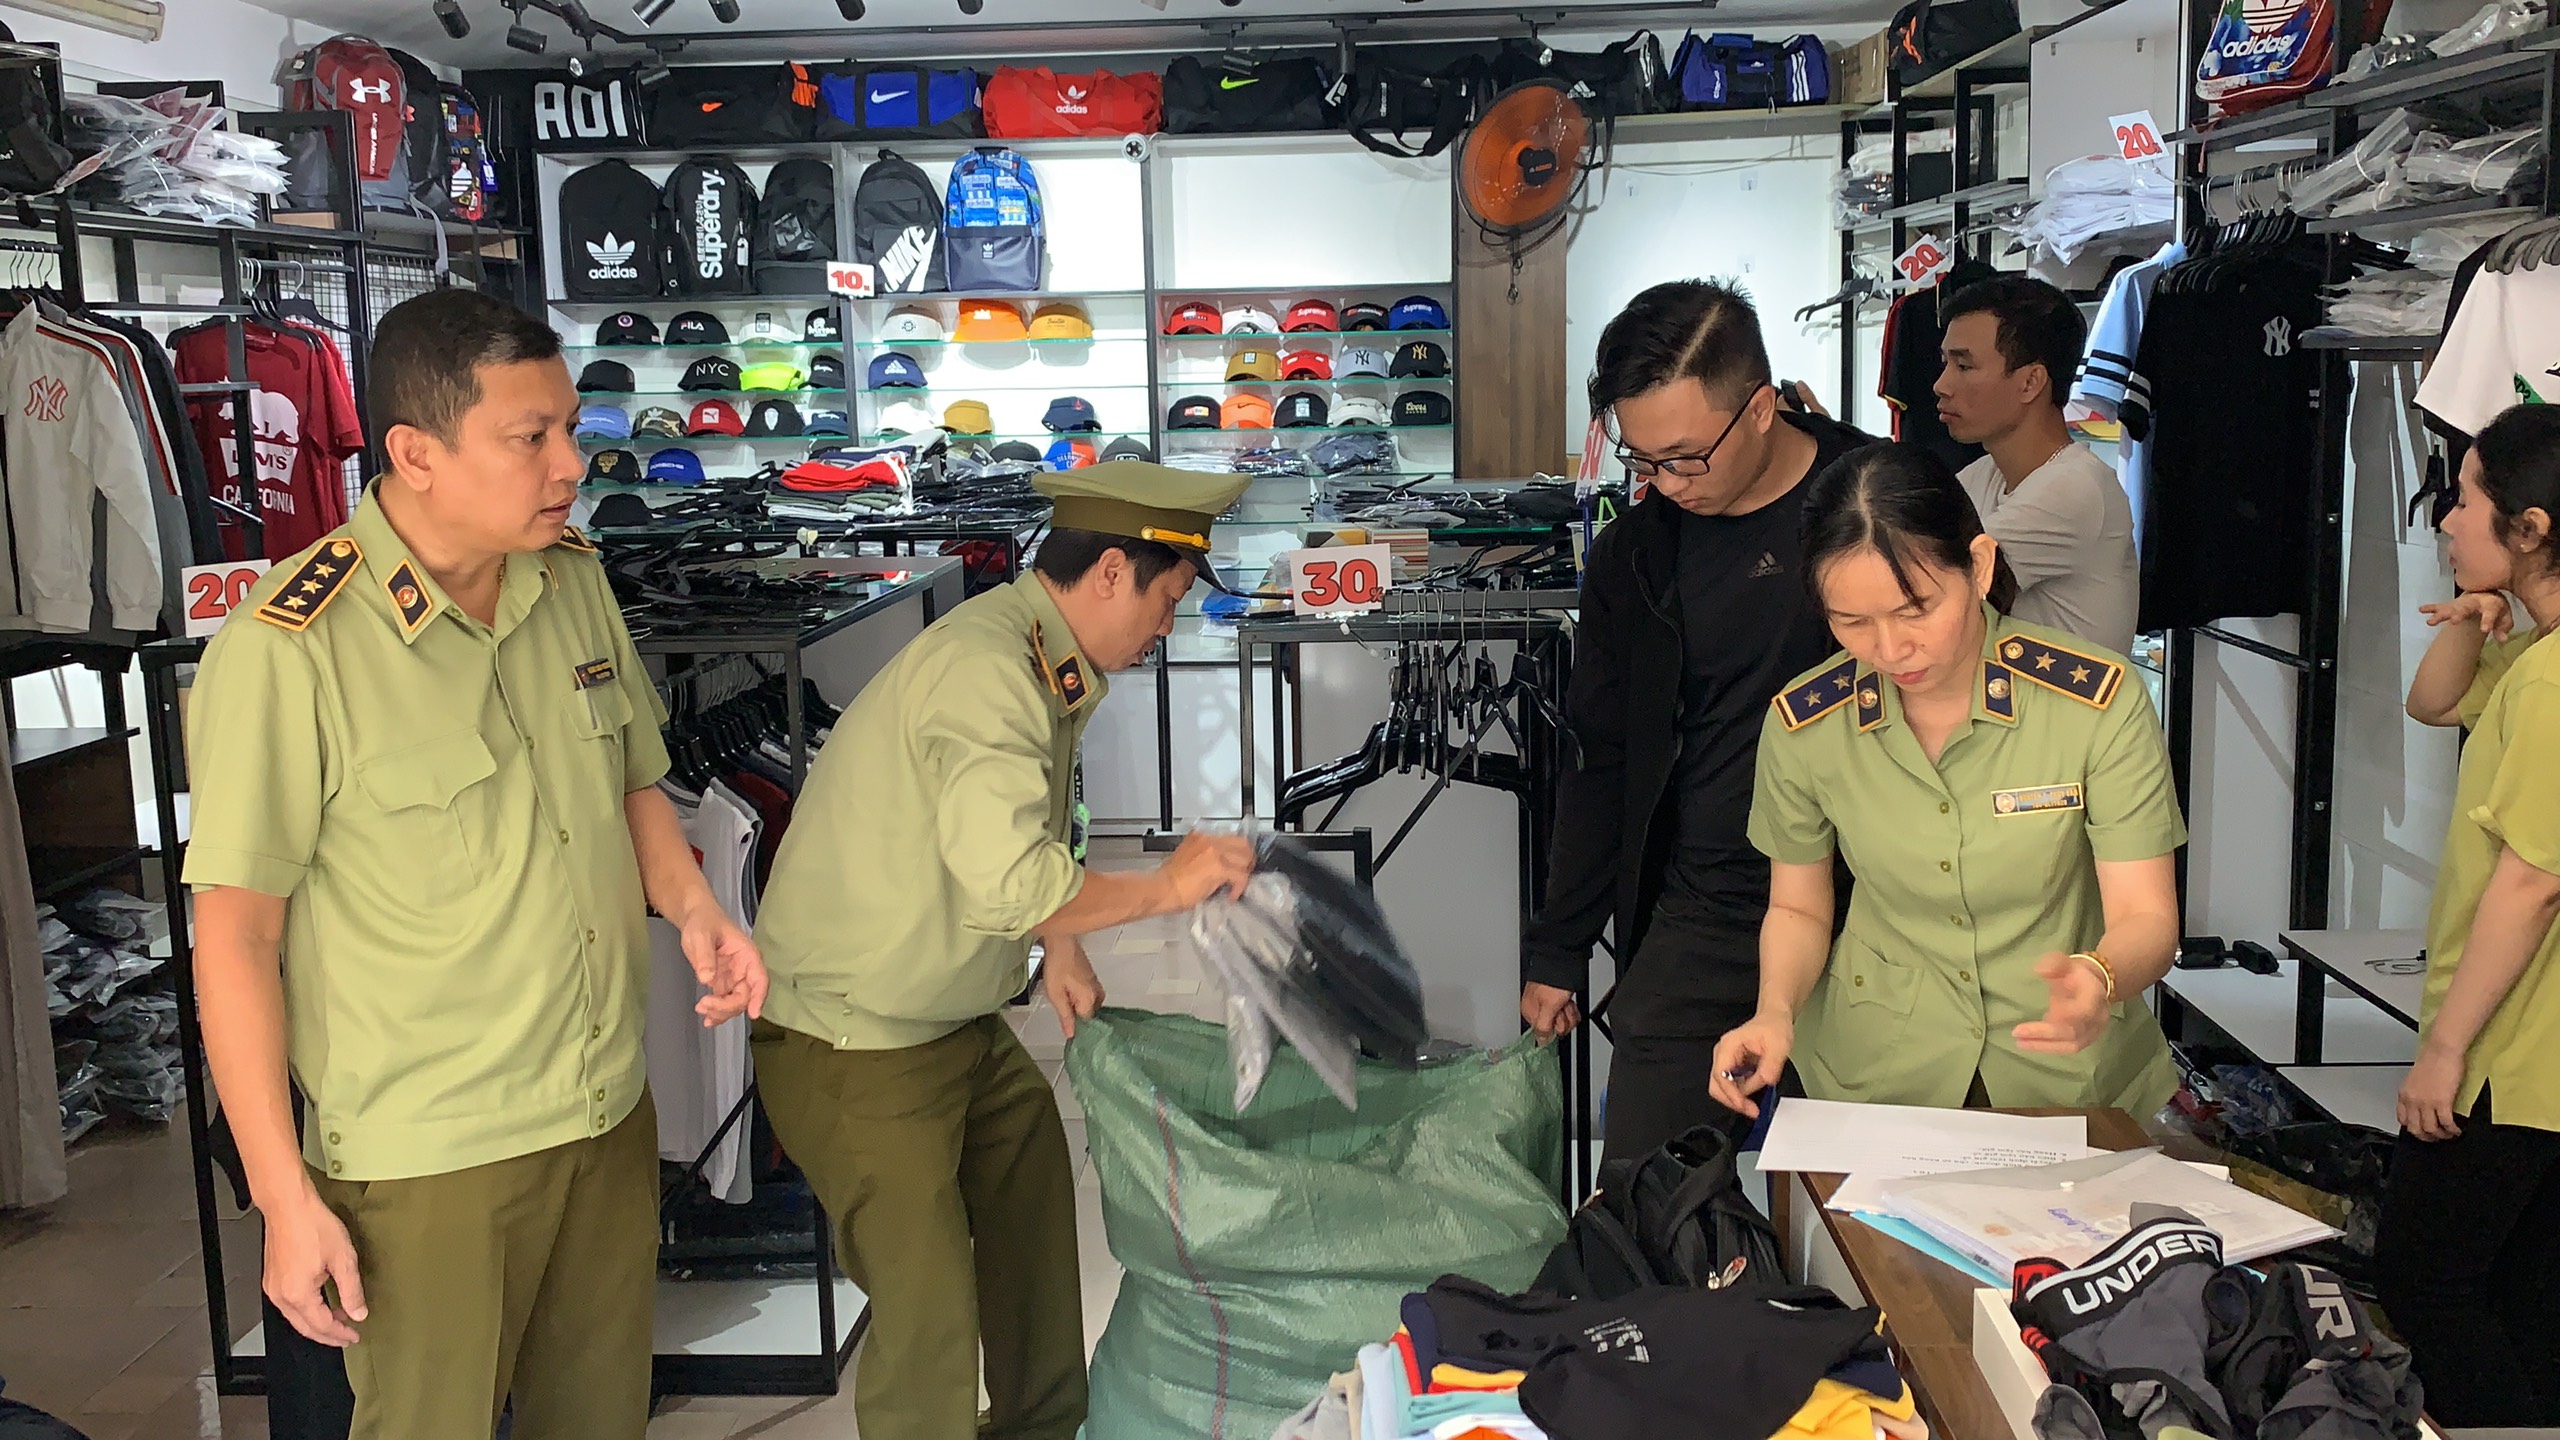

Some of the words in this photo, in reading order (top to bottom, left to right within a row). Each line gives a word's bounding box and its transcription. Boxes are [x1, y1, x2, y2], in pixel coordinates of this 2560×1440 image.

[2222, 33, 2297, 58] adidas
[1056, 104, 1088, 115] adidas
[879, 225, 927, 292] NIKE
[588, 265, 638, 280] adidas
[680, 320, 705, 331] FILA
[696, 363, 730, 377] NYC
[2061, 1233, 2222, 1316] UNDER
